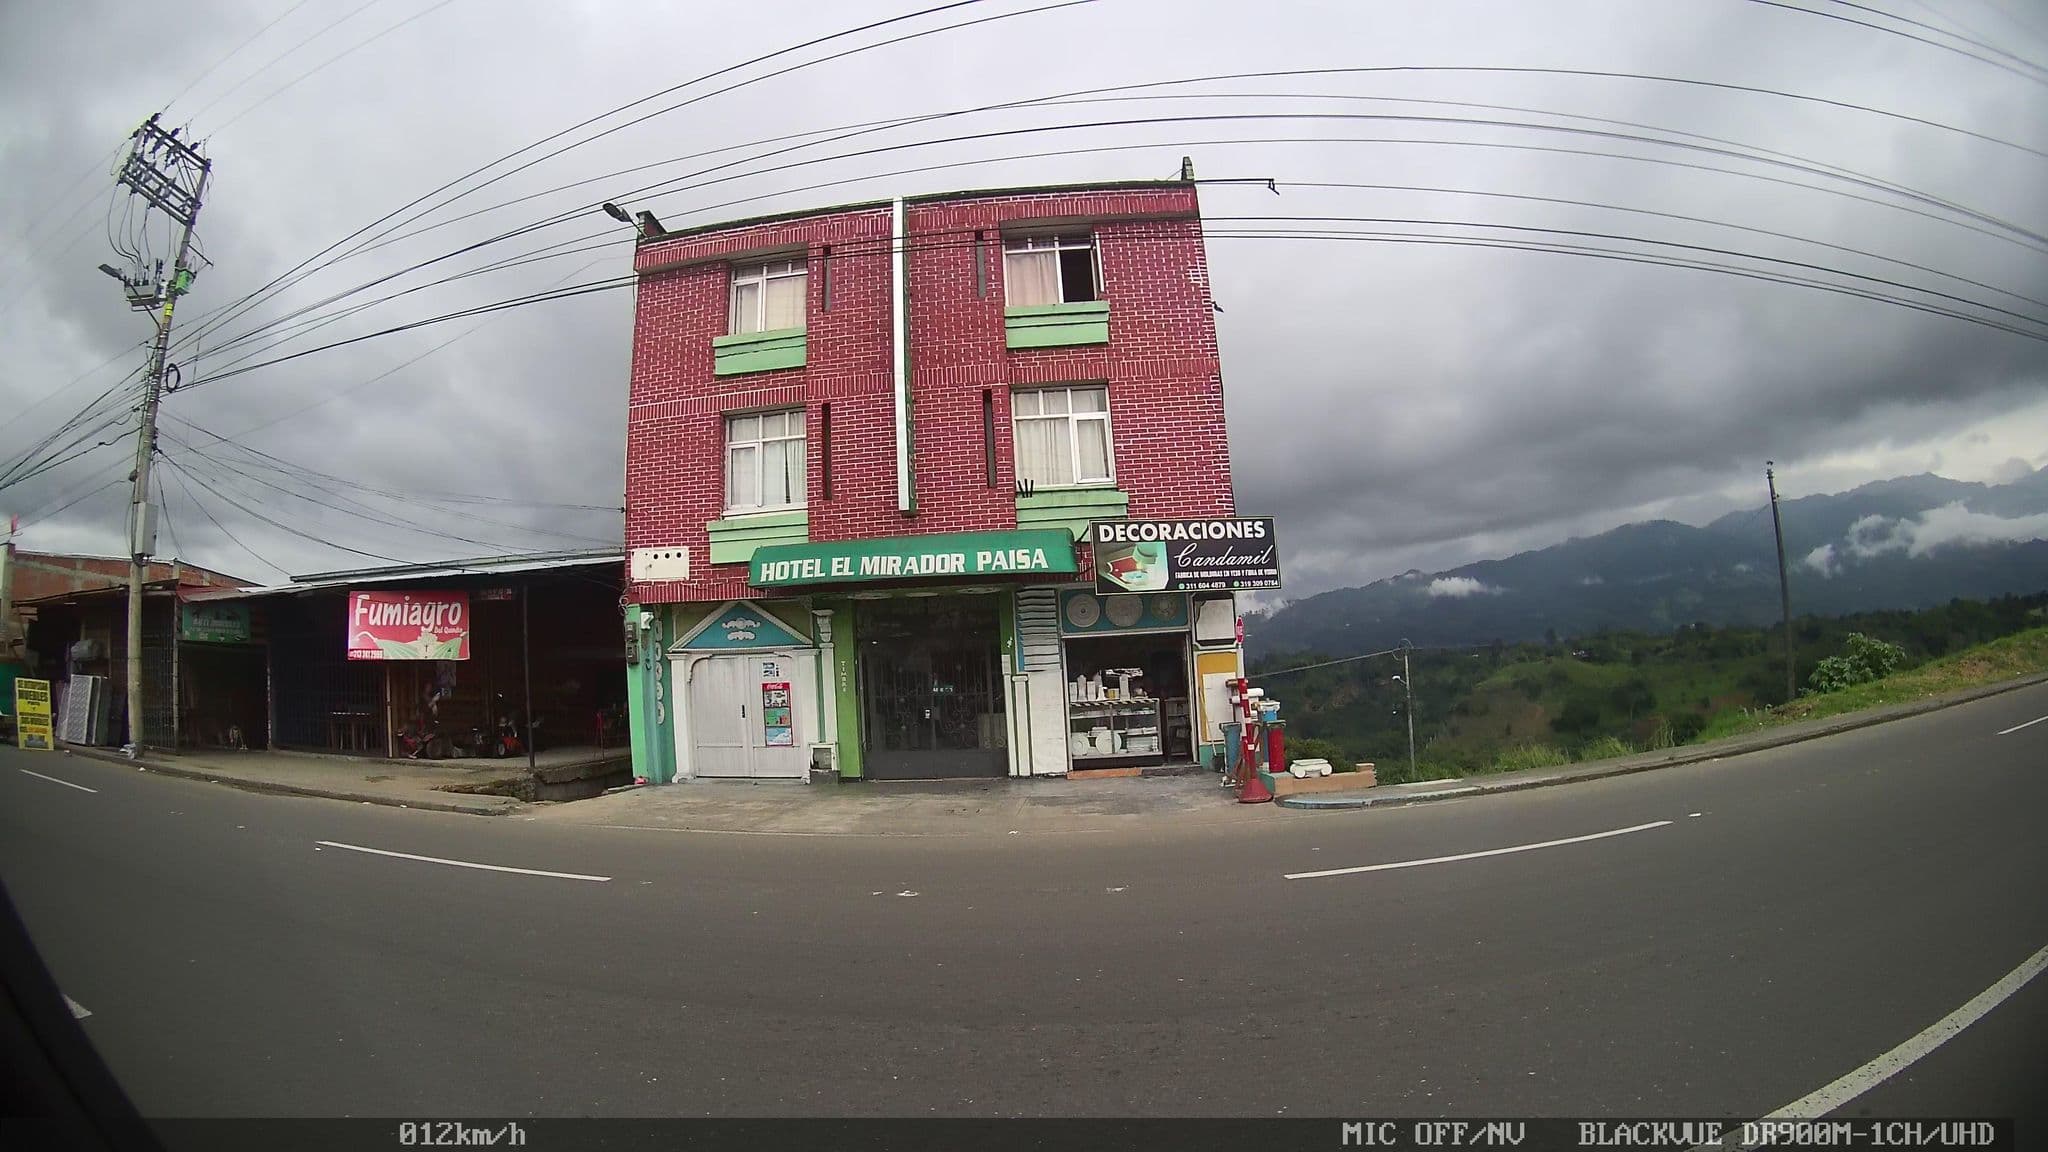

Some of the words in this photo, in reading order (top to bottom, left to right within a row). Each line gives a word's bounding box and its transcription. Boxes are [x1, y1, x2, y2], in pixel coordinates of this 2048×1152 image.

[1098, 521, 1266, 542] DECORACIONES
[759, 558, 826, 582] HOTEL
[830, 557, 855, 577] EL
[859, 553, 966, 576] MIRADOR
[976, 548, 1049, 571] PAISA
[1174, 543, 1274, 568] Candamil
[354, 594, 463, 632] Fumiagro
